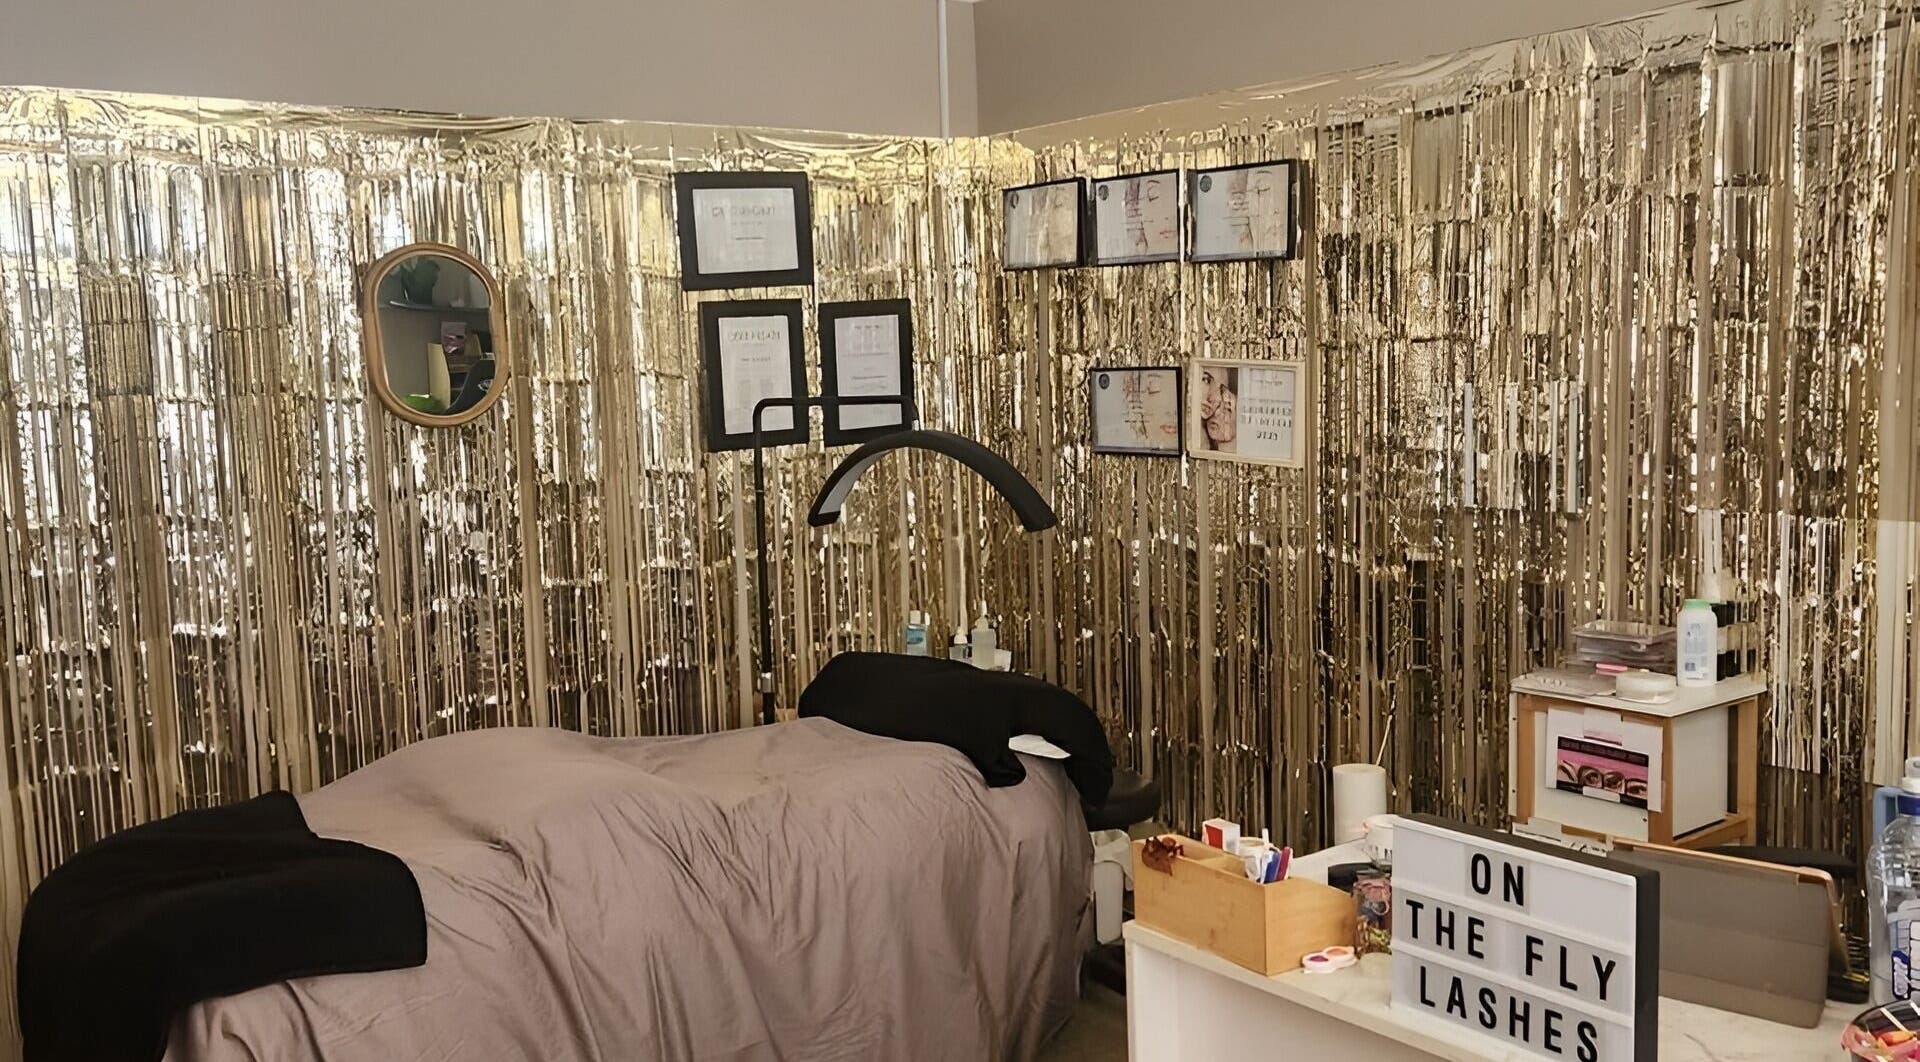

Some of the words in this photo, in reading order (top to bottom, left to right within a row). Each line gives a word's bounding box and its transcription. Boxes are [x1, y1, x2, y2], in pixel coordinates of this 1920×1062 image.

[1471, 853, 1525, 906] ON
[1406, 899, 1485, 960] THE
[1525, 935, 1616, 1001] FLY
[1420, 966, 1598, 1062] LASHES
